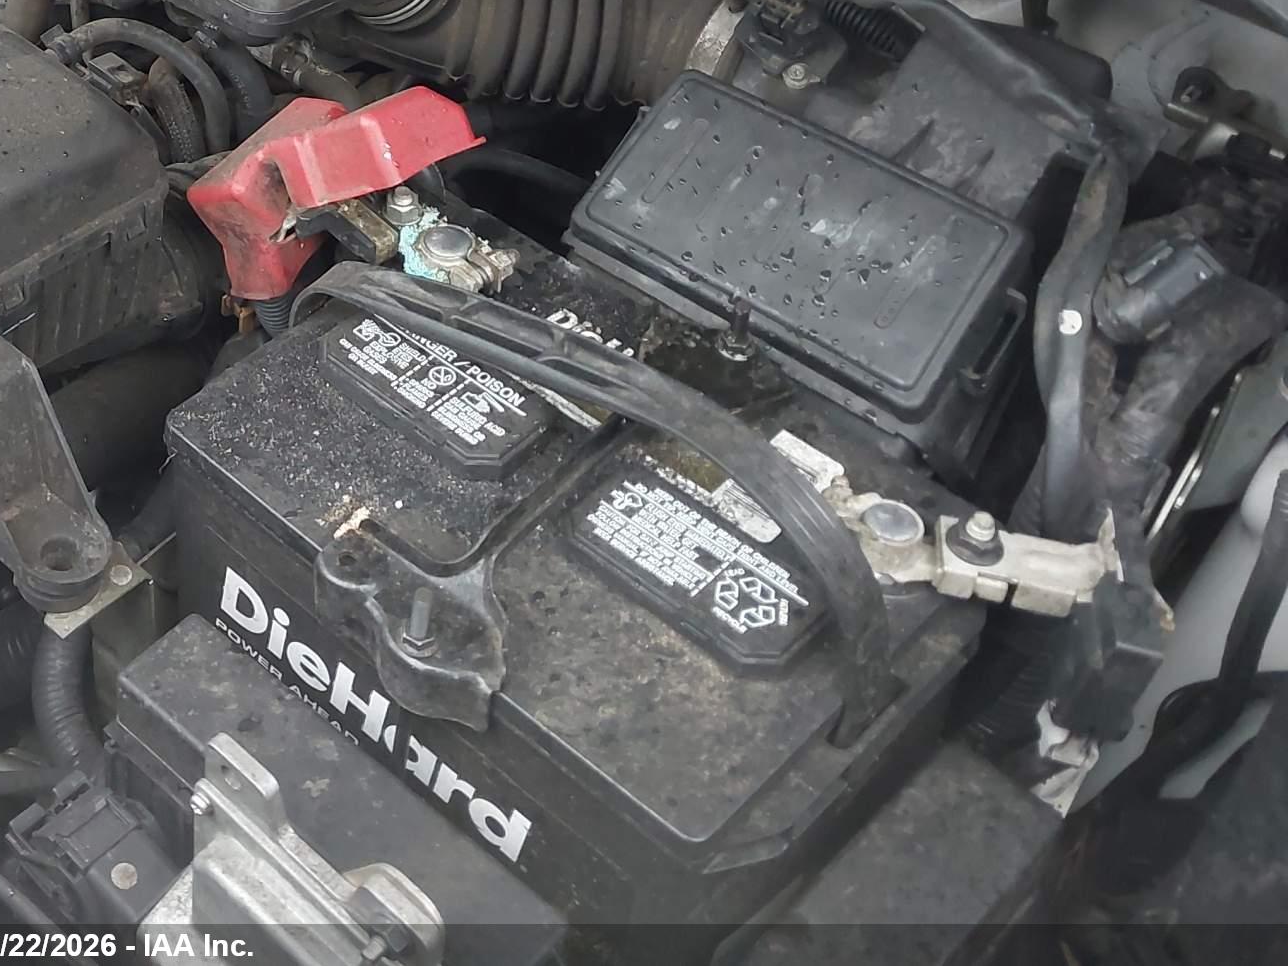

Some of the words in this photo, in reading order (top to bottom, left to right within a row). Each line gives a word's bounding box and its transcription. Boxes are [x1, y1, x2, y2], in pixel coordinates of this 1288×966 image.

[368, 340, 409, 370] EXPLOSIVE
[397, 342, 426, 363] SHIELD
[420, 378, 438, 390] NO
[466, 365, 525, 408] POISON
[483, 421, 507, 437] ACID
[630, 513, 664, 537] MEDICAL
[658, 532, 683, 550] HELP
[677, 544, 700, 562] FAST
[643, 502, 670, 522] FLUSH
[665, 517, 688, 534] EYES
[683, 529, 732, 563] IMMEDIATELY
[750, 552, 790, 581] CHILDREN
[756, 563, 779, 580] AND
[774, 575, 798, 594] LEVEL
[710, 605, 748, 634] RECYCLE
[215, 617, 283, 681] POWER
[220, 566, 532, 864] DieHard
